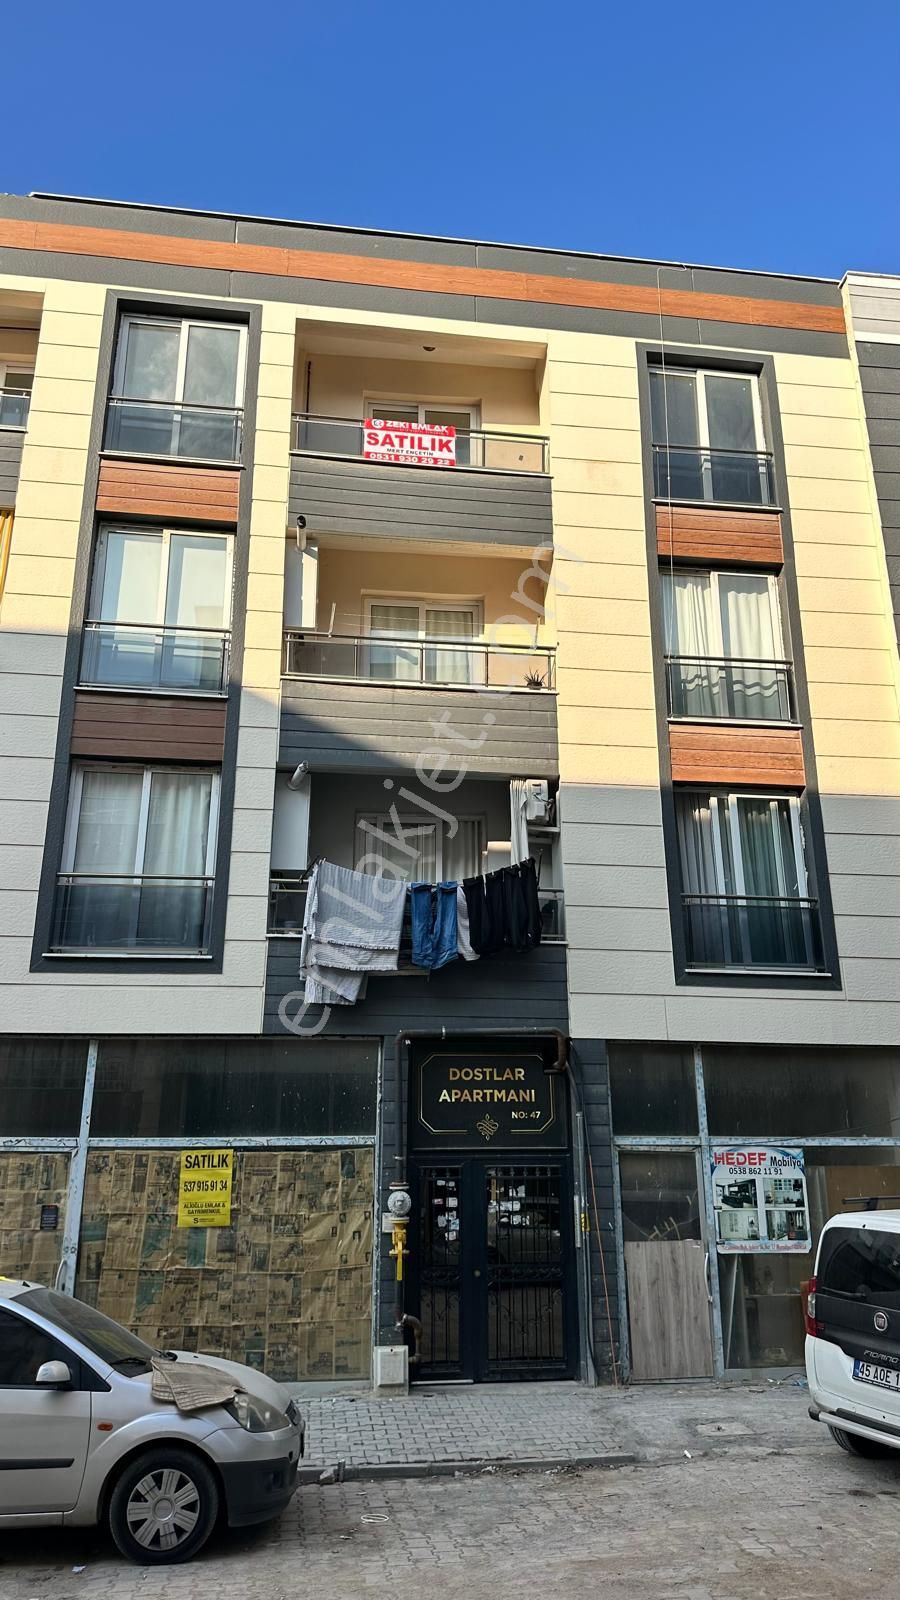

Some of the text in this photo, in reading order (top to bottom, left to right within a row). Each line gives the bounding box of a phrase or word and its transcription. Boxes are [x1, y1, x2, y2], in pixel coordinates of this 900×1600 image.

[411, 422, 449, 433] EMLAK
[366, 432, 453, 453] SATILIK
[369, 453, 395, 462] 0531
[398, 455, 418, 463] 930
[449, 1067, 525, 1081] DOSTLAR
[438, 1088, 536, 1103] APARTMANI
[511, 1111, 541, 1119] NO: 47
[184, 1153, 229, 1169] SATILIK
[714, 1152, 801, 1169] HEDEF Mobilya
[728, 1167, 783, 1175] 0538 862 11 91
[183, 1179, 228, 1193] 537 915 91 34
[859, 1363, 872, 1378] 45
